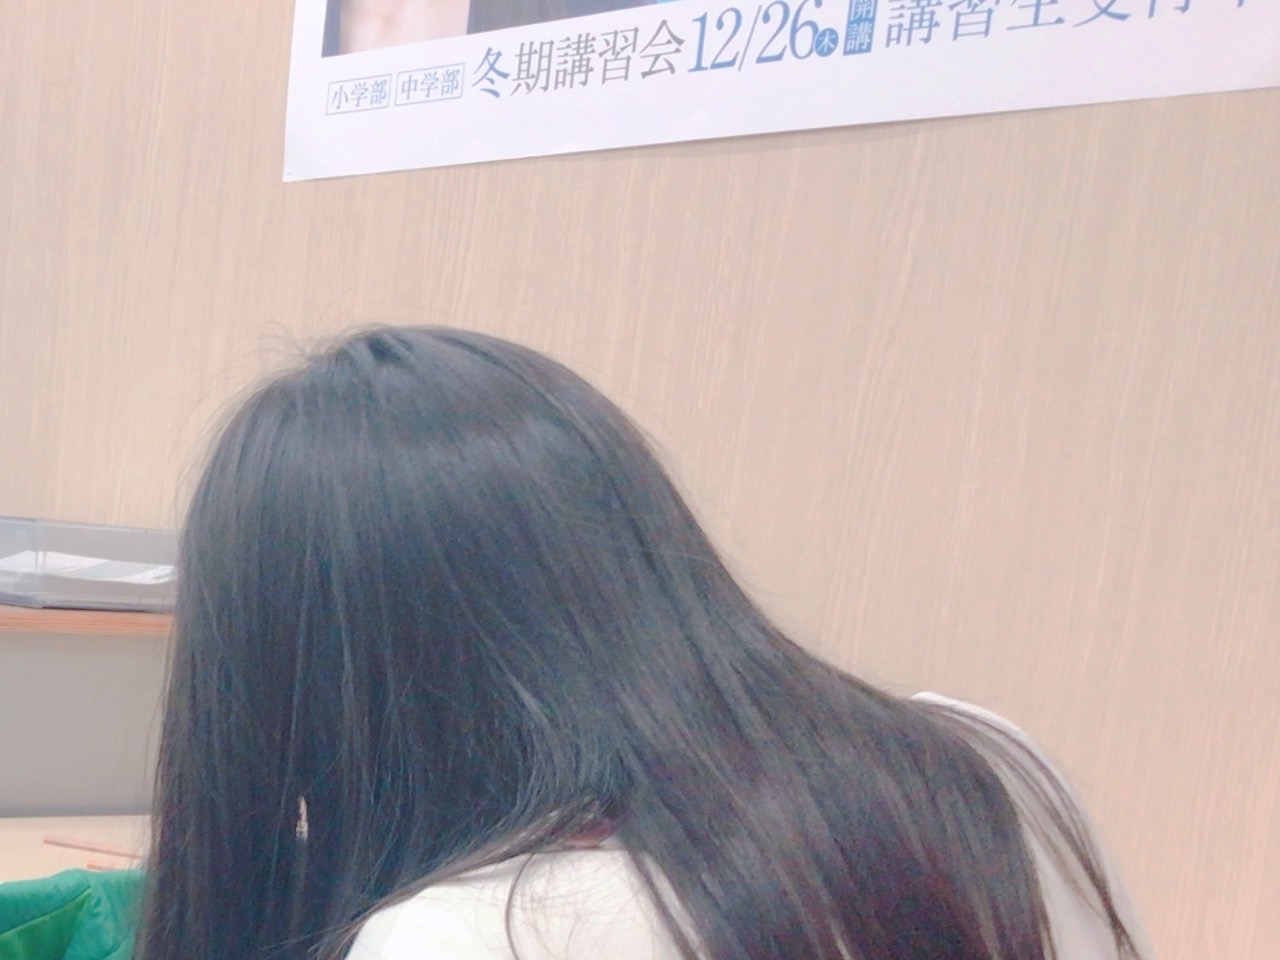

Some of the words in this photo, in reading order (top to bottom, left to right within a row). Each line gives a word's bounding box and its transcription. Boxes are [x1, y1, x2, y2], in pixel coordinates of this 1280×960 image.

[330, 79, 388, 111] 小学部
[401, 68, 462, 101] 中学部
